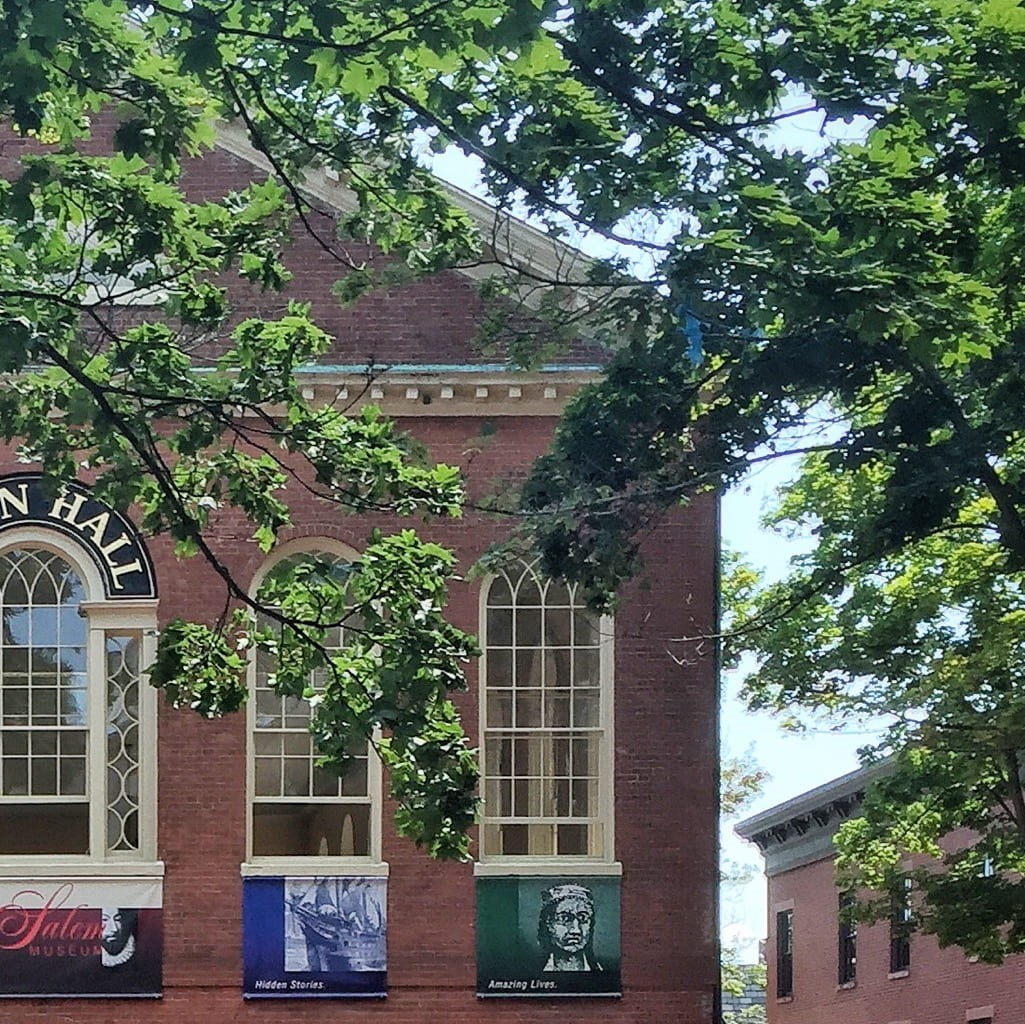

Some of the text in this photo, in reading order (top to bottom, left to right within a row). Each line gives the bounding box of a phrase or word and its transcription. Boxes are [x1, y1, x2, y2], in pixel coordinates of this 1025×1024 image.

[48, 492, 143, 590] HALL
[255, 980, 288, 991] Hidden
[488, 979, 558, 991] Amazing Lives.
